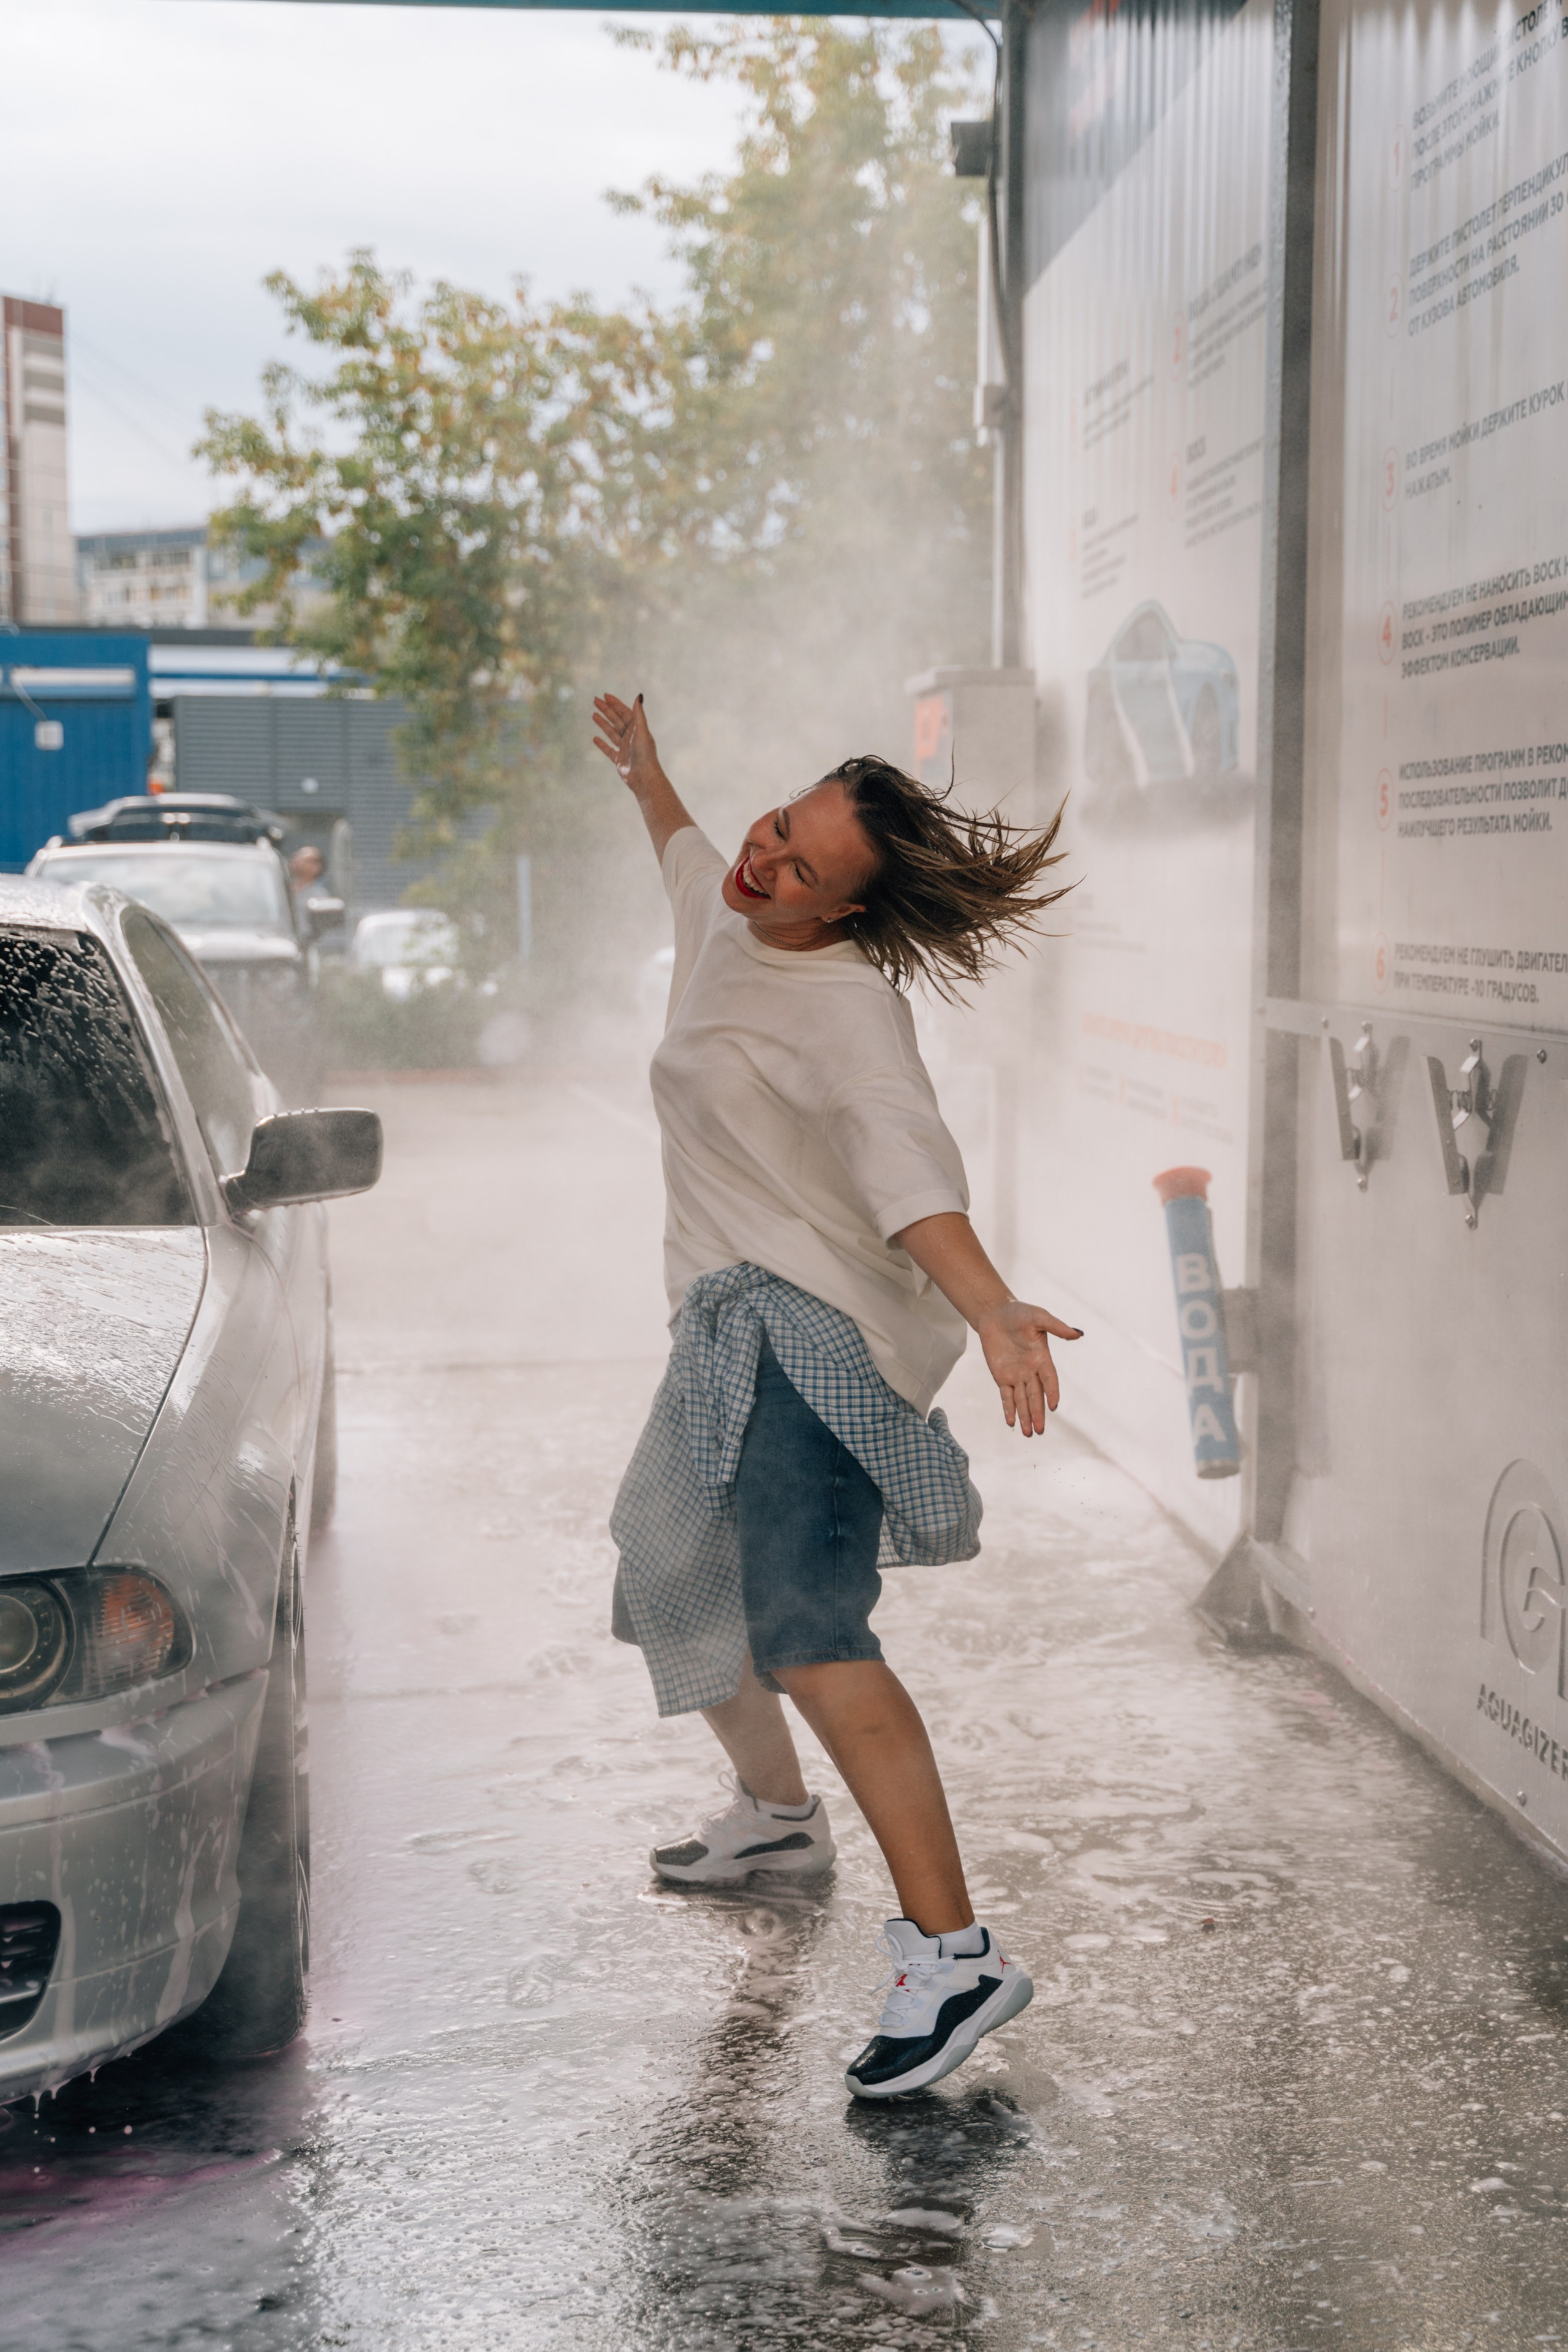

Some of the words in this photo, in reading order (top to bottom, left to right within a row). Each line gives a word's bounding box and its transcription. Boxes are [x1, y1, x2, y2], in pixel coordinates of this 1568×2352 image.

[1412, 124, 1440, 160] ПОСЛЕ
[1516, 21, 1559, 77] КНОПКУ
[1412, 134, 1464, 190] ПРОГРАММЫ
[1409, 235, 1450, 280] ДЕРЖИТЕ
[1452, 202, 1497, 250] ПИСТОЛЕТ
[1409, 252, 1469, 306] ПОВЕРХНОСТИ
[1471, 243, 1485, 268] НА
[1487, 200, 1548, 258] РАССТОЯНИИ
[1550, 190, 1564, 217] 30
[1389, 286, 1398, 322] 2
[1409, 314, 1420, 337] ОТ
[1421, 294, 1455, 331] КУЗОВА
[1455, 254, 1520, 310] АВТОМОБИЛЯ.
[1406, 450, 1418, 470] ВО
[1419, 435, 1447, 466] ВРЕМЯ
[1449, 421, 1480, 452] МОЙКИ
[1481, 398, 1527, 441] ДЕРЖИТЕ
[1529, 380, 1565, 416] КУРОК
[1402, 588, 1464, 621] РЕКОМЕНДУЕМ
[1465, 582, 1478, 603] НЕ
[1479, 567, 1531, 600] НАНОСИТЬ
[1532, 556, 1561, 585] ВОСК
[1382, 614, 1392, 648] 4
[1401, 628, 1425, 650] ВОСК
[1431, 622, 1448, 643] ЭТО
[1449, 609, 1492, 639] ПОЛИМЕР
[1401, 652, 1449, 679] ЭФФЕКТОМ
[1450, 635, 1520, 669] КОНСЕРВАЦИИ.
[1399, 755, 1473, 781] ИСПОЛЬЗОВАНИЕ
[1474, 748, 1526, 773] ПРОГРАММ
[1528, 747, 1534, 767] В
[1380, 783, 1389, 817] 5
[1398, 783, 1502, 812] ПОСЛЕДОВАТЕЛЬНОСТИ
[1503, 777, 1558, 802] ПОЗВОЛИТ
[1397, 816, 1456, 839] НАИЛУЧШЕГО
[1457, 813, 1512, 836] РЕЗУЛЬТАТА
[1512, 807, 1553, 833] МОЙКИ.
[1394, 943, 1455, 966] РЕКОМЕНДУЕМ
[1457, 946, 1469, 965] НЕ
[1471, 948, 1514, 969] ГЛУШИТЬ
[1394, 971, 1409, 990] ПРИ
[1411, 973, 1469, 996] ТЕМПЕРАТУРЕ
[1485, 980, 1540, 1004] ГРАДУСОВ.
[1175, 1253, 1227, 1446] ВОДА
